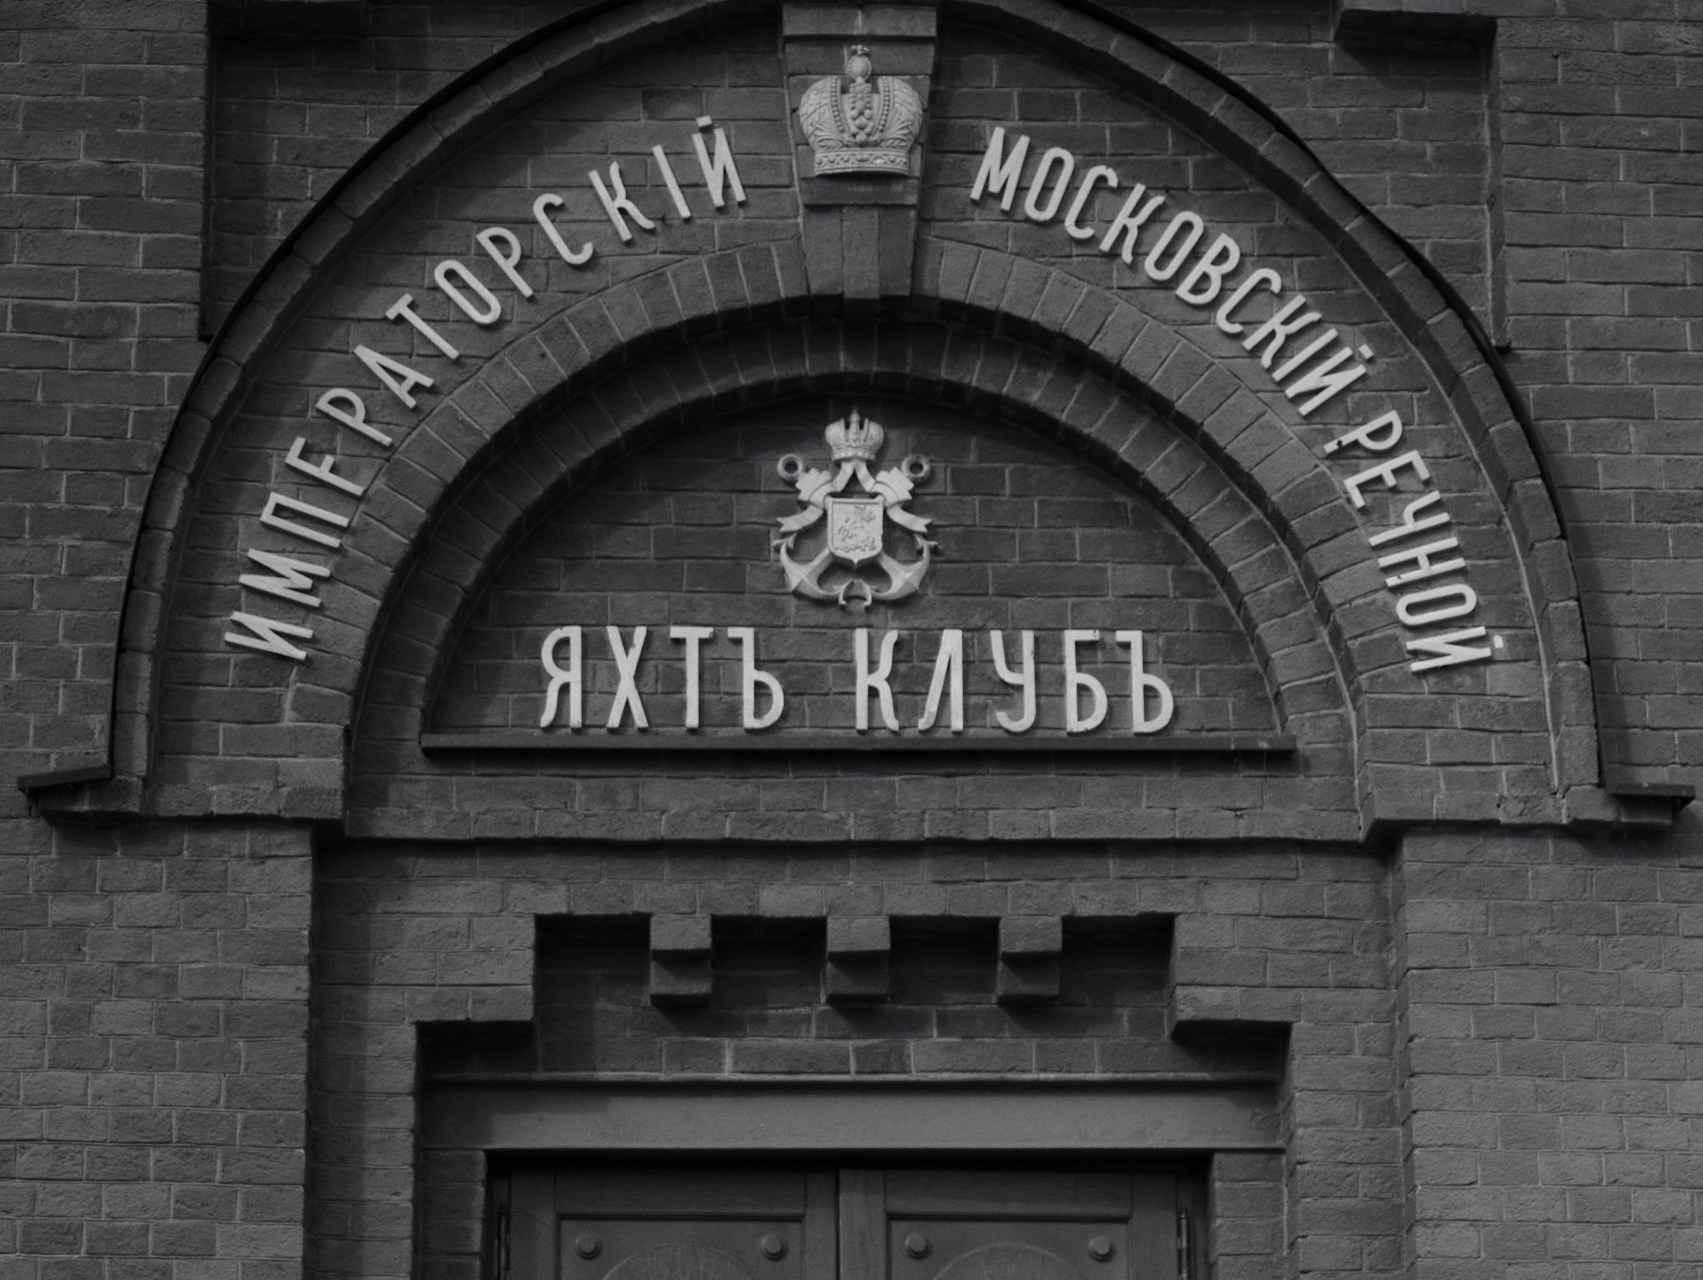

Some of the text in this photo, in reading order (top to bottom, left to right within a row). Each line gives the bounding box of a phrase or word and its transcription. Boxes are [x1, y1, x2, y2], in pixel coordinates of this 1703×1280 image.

[1322, 409, 1505, 673] РЕЧНОЙ
[539, 625, 1174, 734] ЯХТЪ КЛУБЪ
